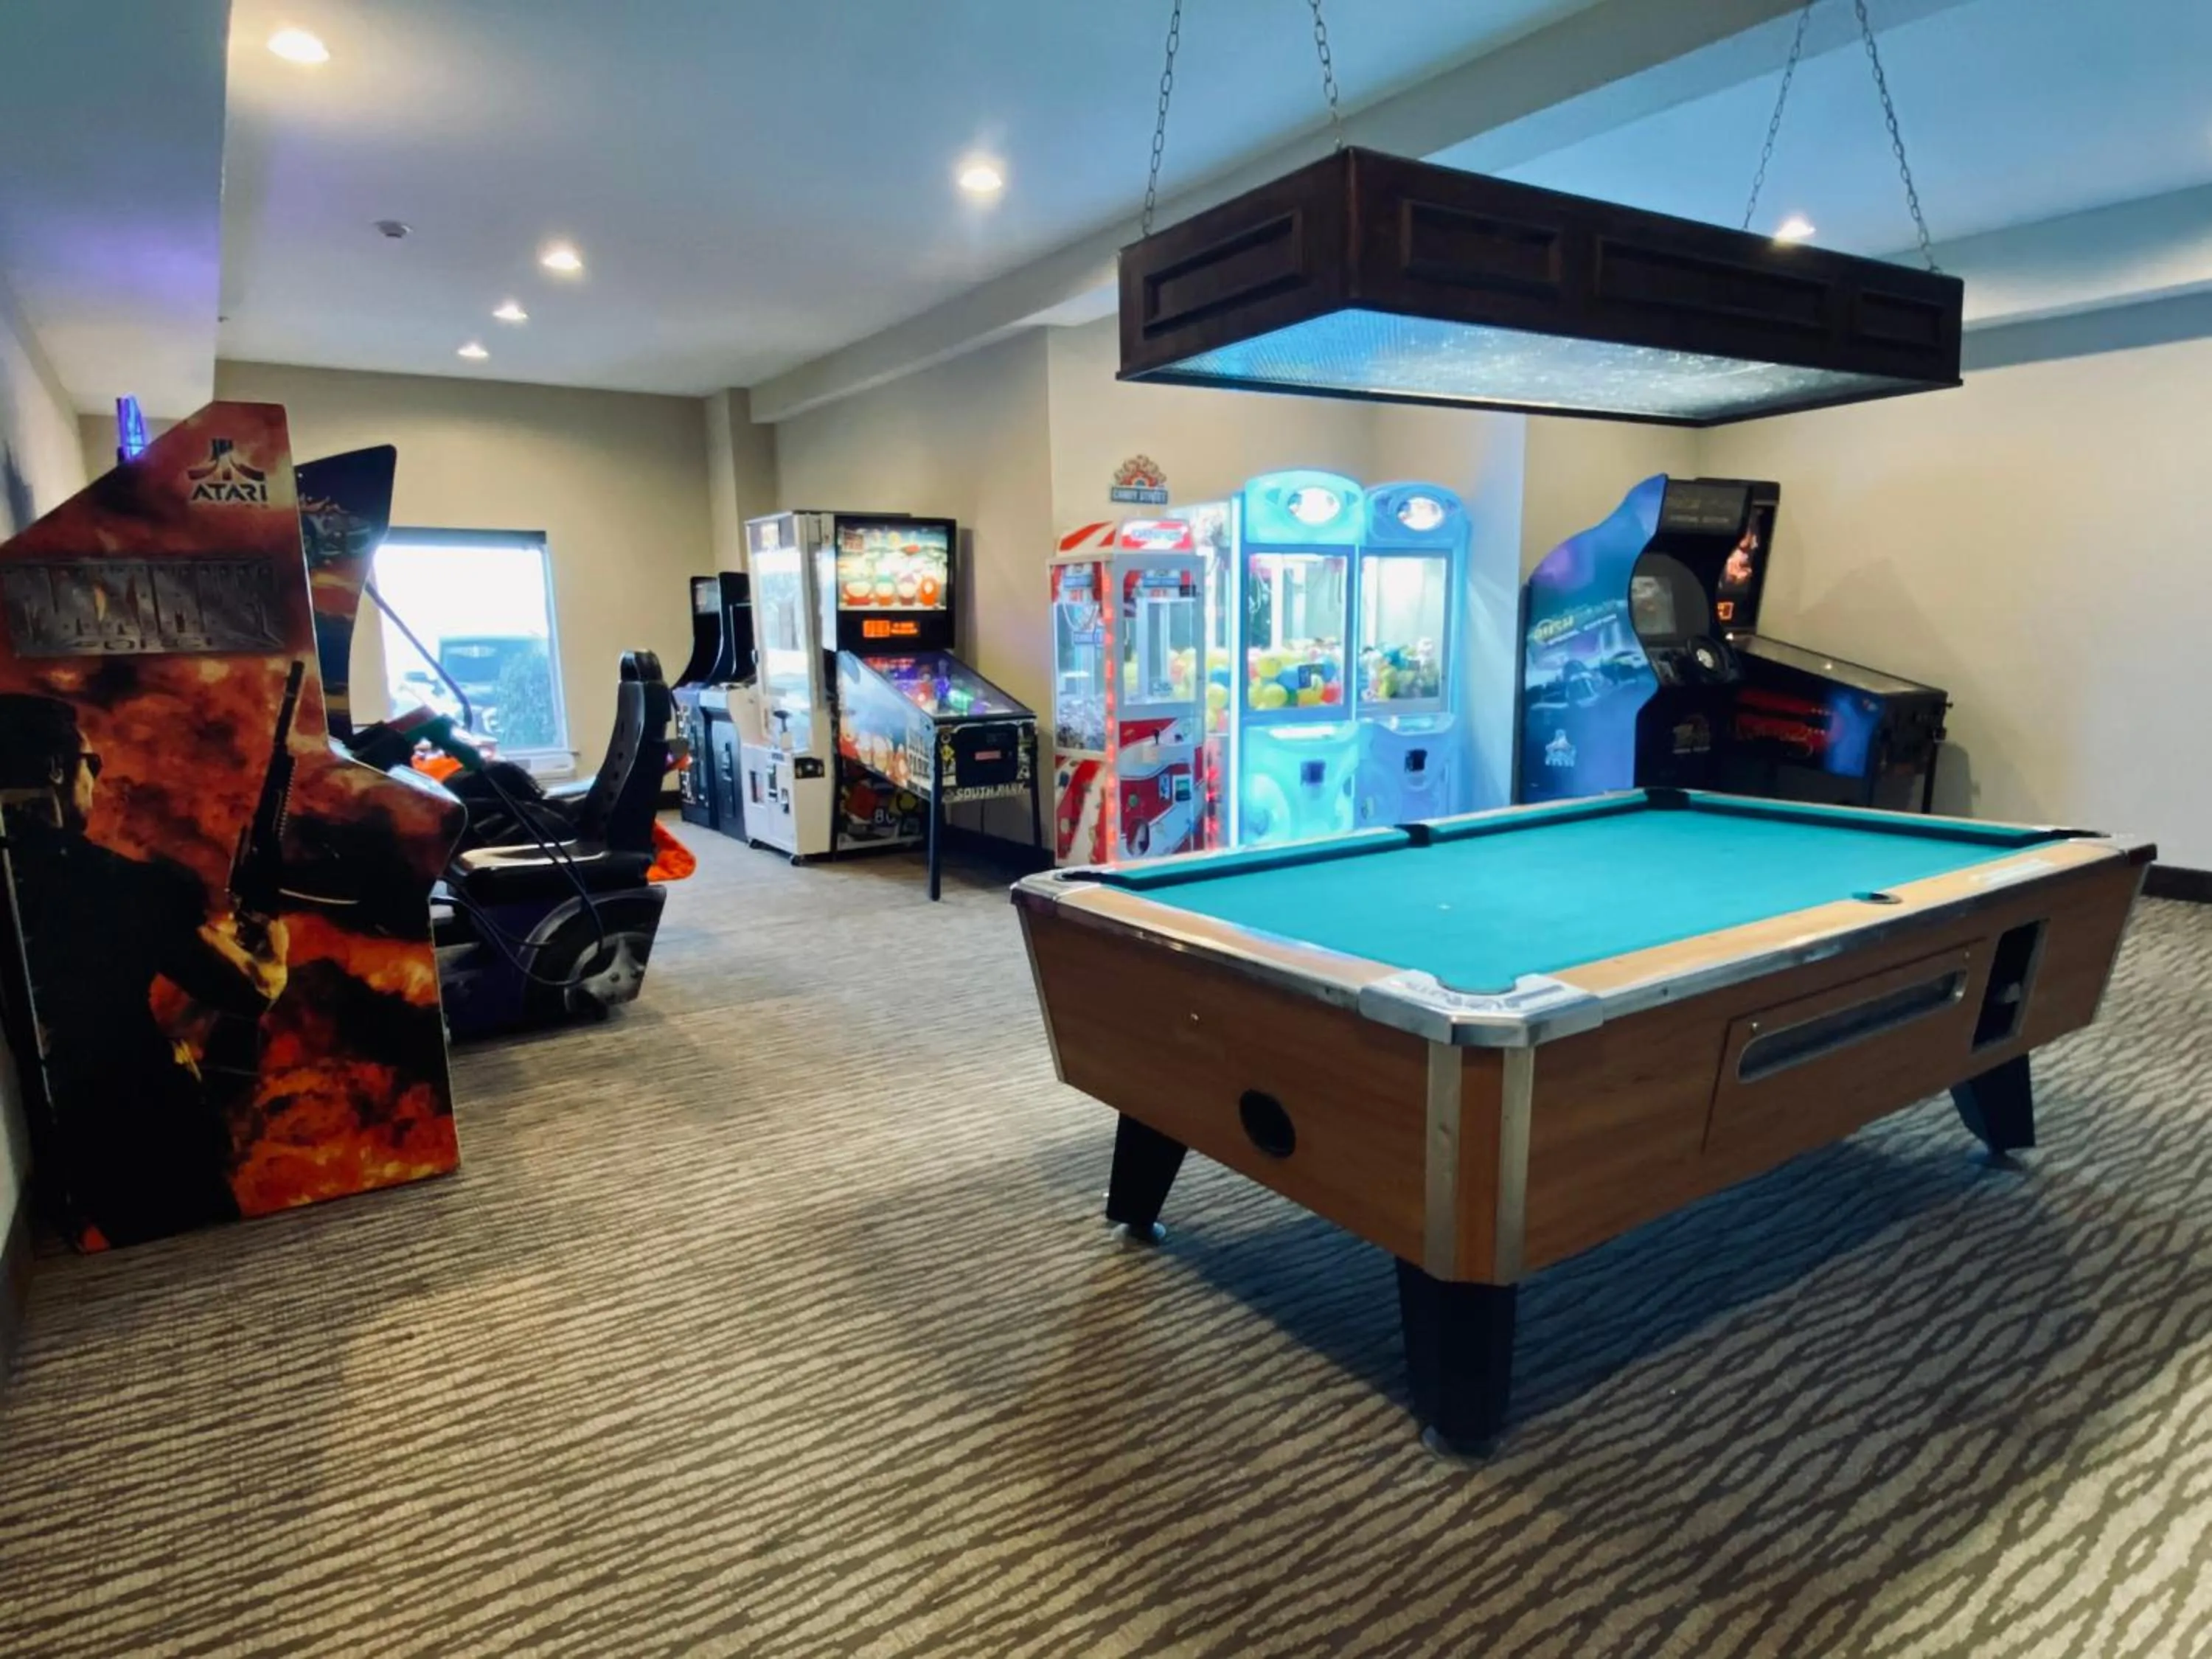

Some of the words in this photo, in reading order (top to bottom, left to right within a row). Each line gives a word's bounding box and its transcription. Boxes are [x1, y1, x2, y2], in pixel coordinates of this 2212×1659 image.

[192, 483, 268, 502] ATARI
[956, 785, 994, 799] SOUTH
[997, 781, 1026, 796] PARK
